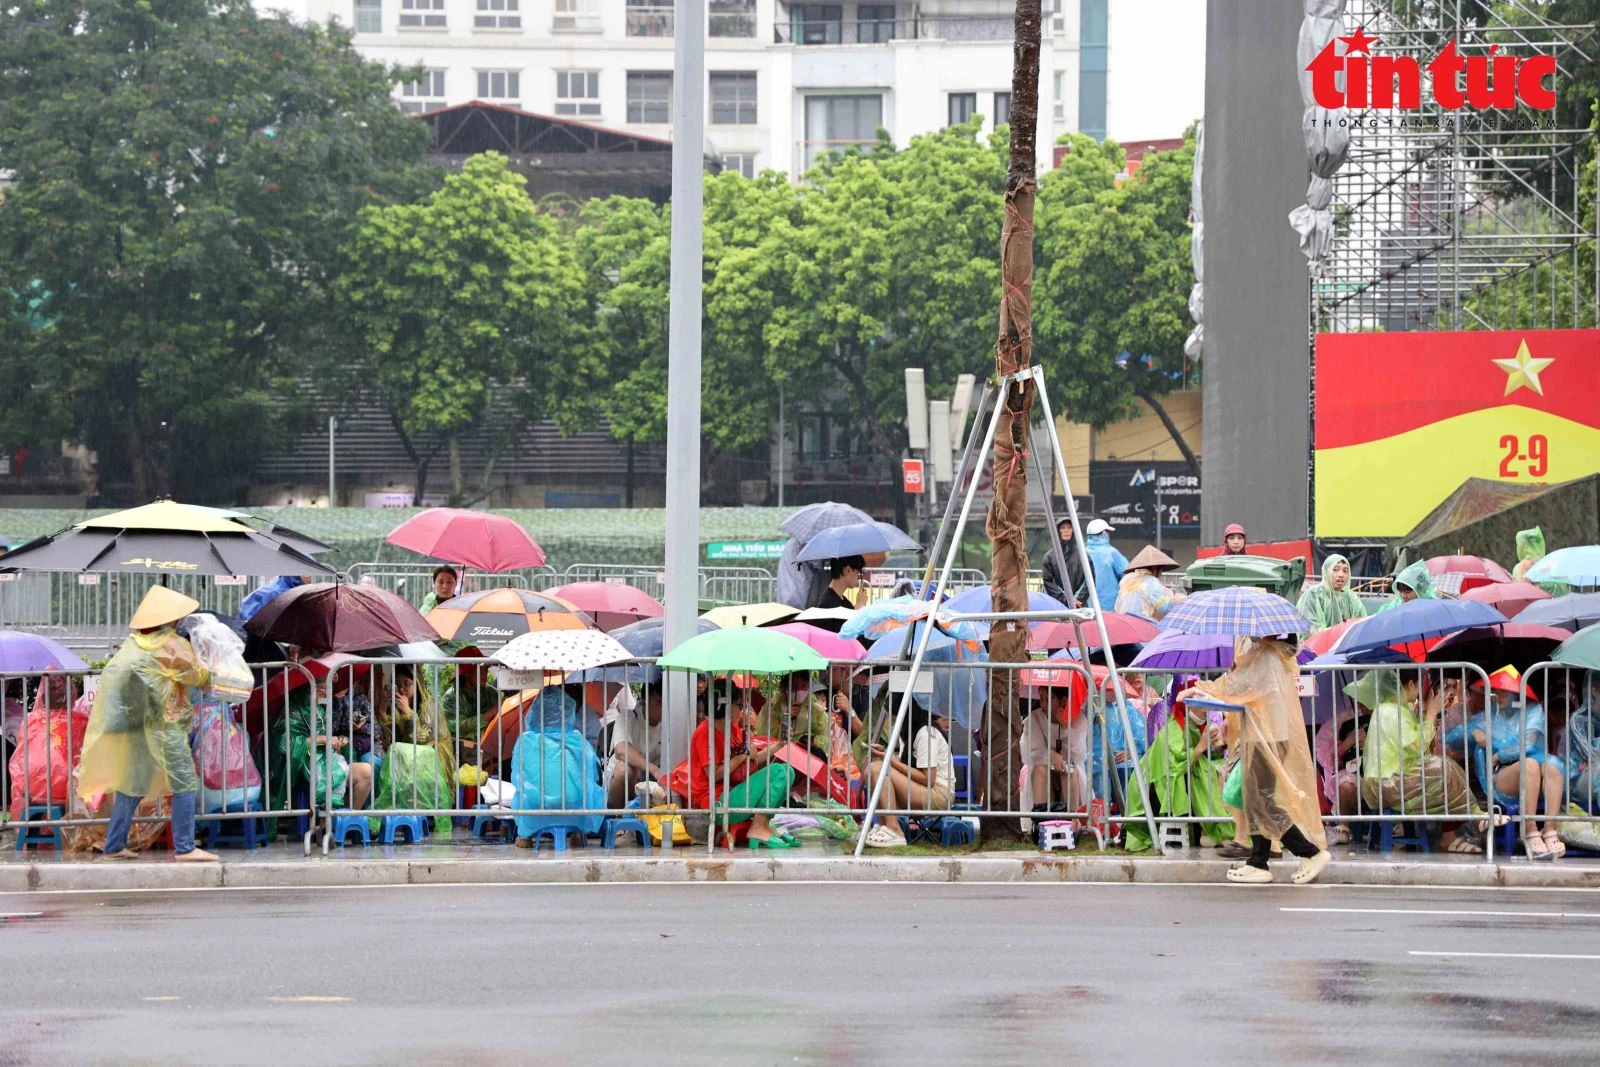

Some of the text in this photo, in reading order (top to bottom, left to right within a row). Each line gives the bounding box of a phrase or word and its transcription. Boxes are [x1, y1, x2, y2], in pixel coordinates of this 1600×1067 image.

[1499, 434, 1548, 477] 2-9
[470, 626, 514, 636] Titleist
[508, 677, 534, 686] STOP
